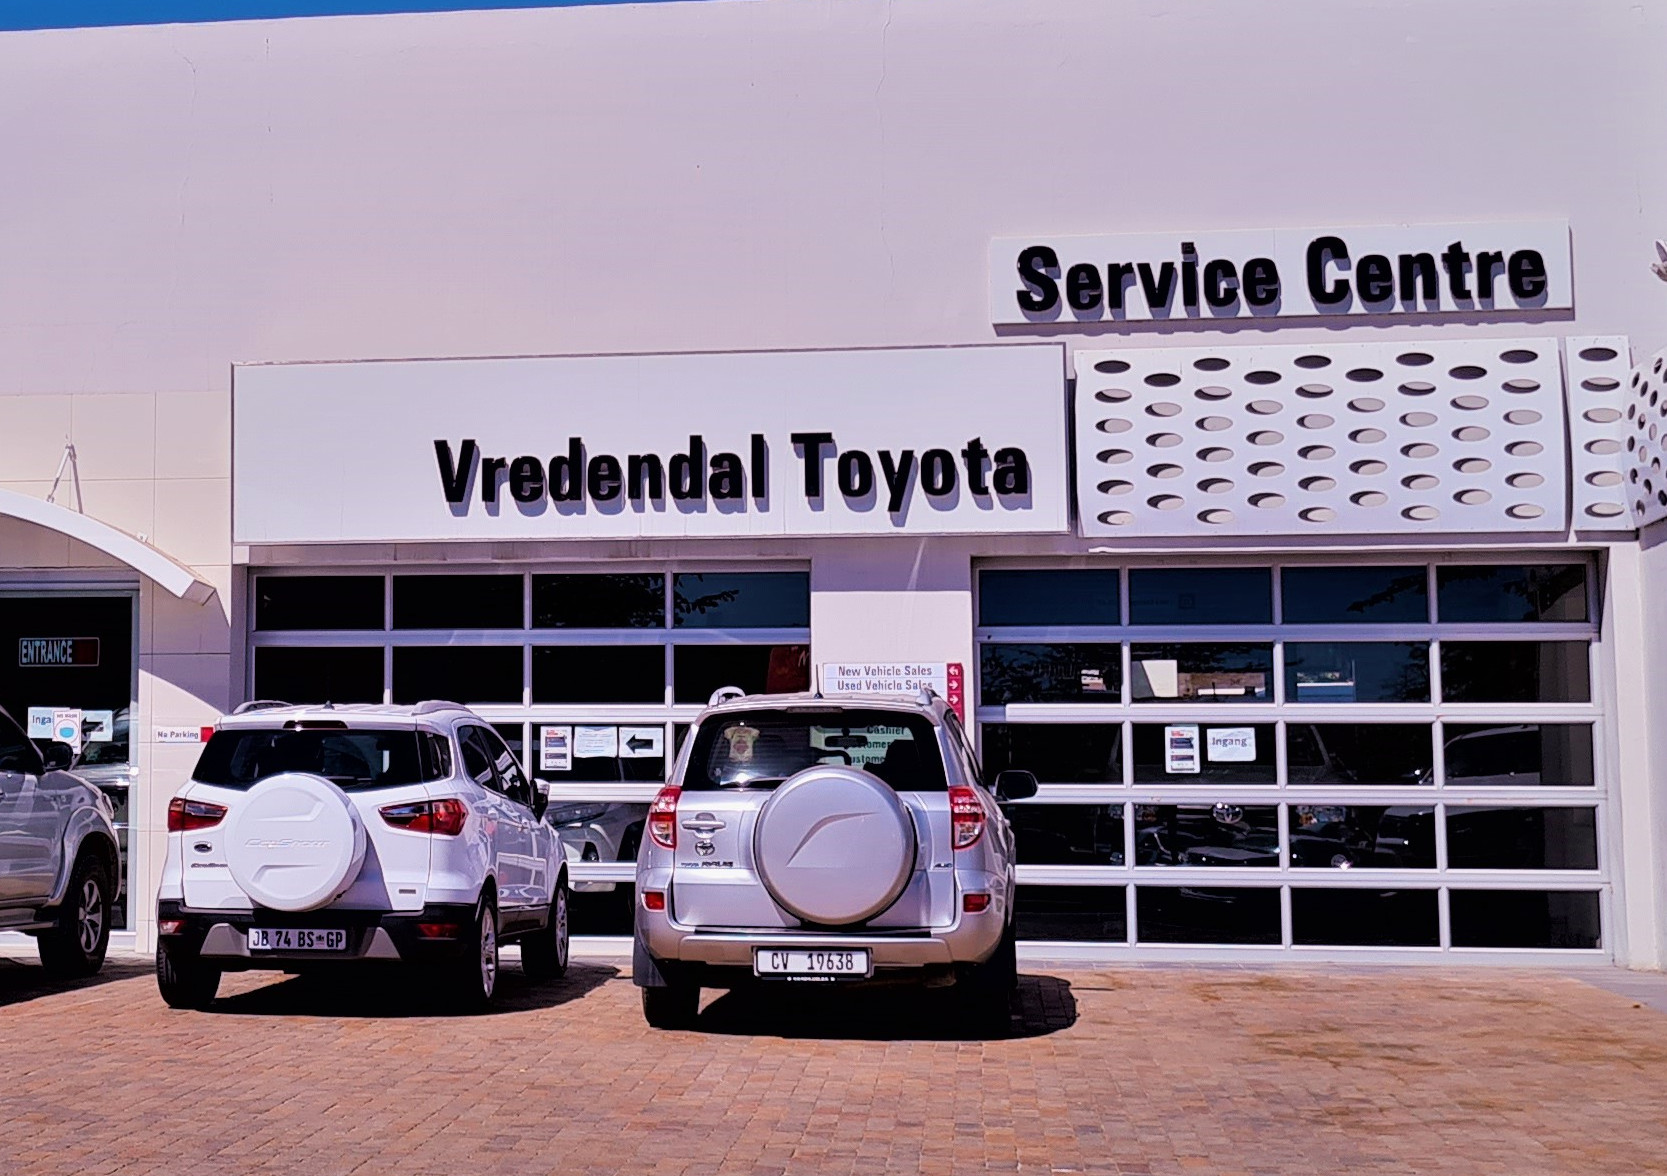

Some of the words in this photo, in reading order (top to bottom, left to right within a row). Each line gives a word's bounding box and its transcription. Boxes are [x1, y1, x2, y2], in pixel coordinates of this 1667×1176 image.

[1015, 241, 1279, 312] Service
[1306, 236, 1546, 308] Centre
[433, 433, 766, 503] Vredendal
[790, 431, 1029, 513] Toyota
[21, 640, 73, 664] ENTRANCE
[838, 666, 861, 676] New
[864, 665, 901, 677] Vehicle
[904, 665, 933, 676] Sales
[837, 680, 862, 691] Used
[865, 680, 902, 691] Vehicle
[32, 715, 53, 726] Inga
[170, 730, 199, 740] Parking
[1211, 737, 1248, 747] Ingang
[275, 930, 292, 947] 74
[297, 931, 315, 947] BS
[326, 931, 343, 947] GP
[771, 952, 790, 970] CV
[807, 953, 854, 970] 19638
